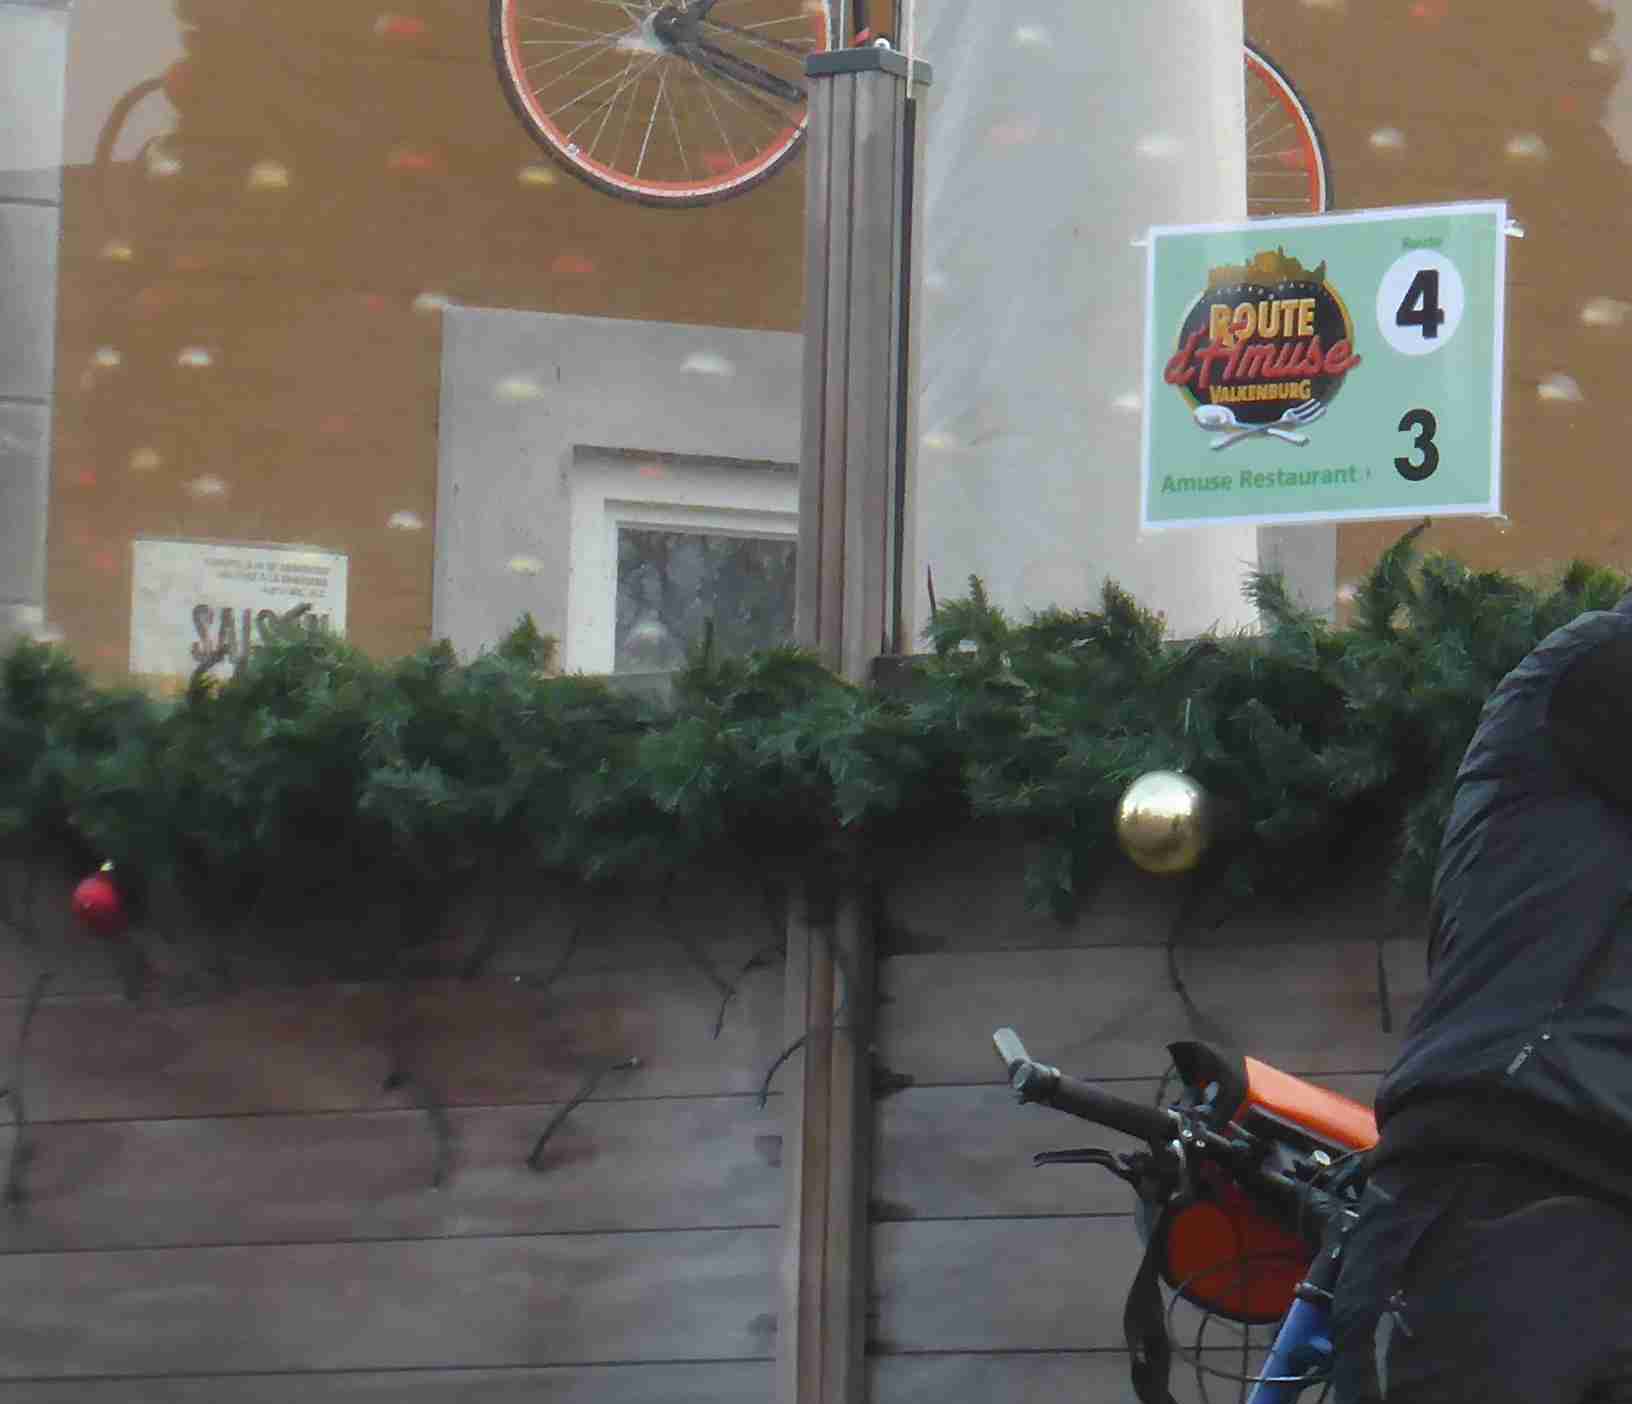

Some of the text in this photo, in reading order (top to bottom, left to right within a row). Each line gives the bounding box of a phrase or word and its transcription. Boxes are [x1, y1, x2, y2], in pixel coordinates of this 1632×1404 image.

[1209, 298, 1316, 347] ROUTE
[1396, 269, 1445, 339] 4
[1209, 379, 1312, 404] VALKENBURG
[1394, 408, 1440, 482] 3
[1161, 463, 1358, 494] Amuse Restaurant
